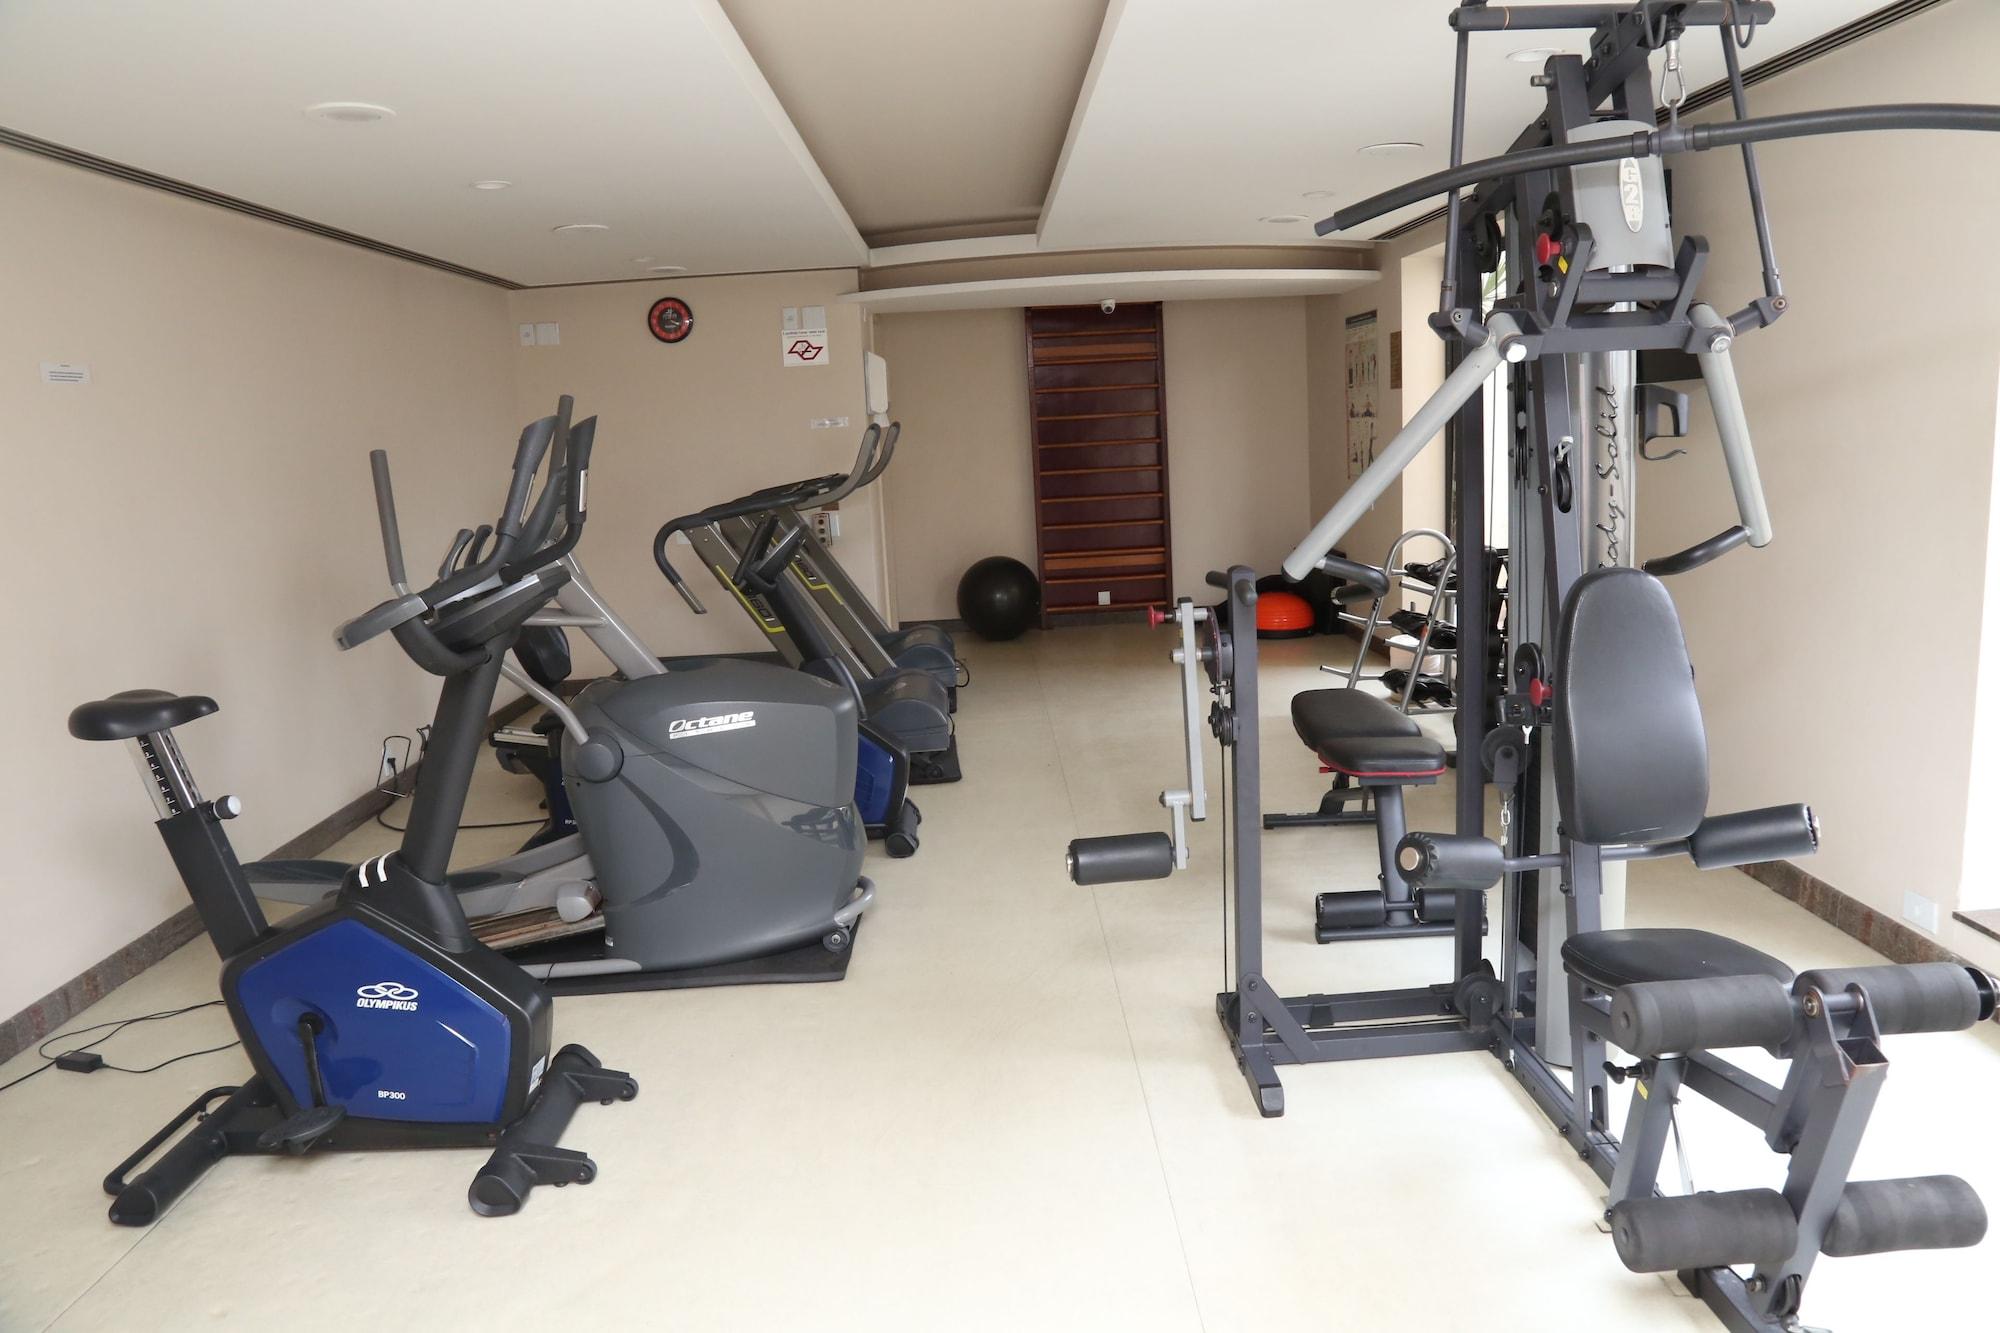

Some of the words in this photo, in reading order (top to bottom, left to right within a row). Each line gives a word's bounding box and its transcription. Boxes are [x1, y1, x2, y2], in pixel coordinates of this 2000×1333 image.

[668, 711, 754, 733] Octane
[356, 998, 419, 1011] OLYMPIKUS
[377, 1090, 406, 1100] BP300
